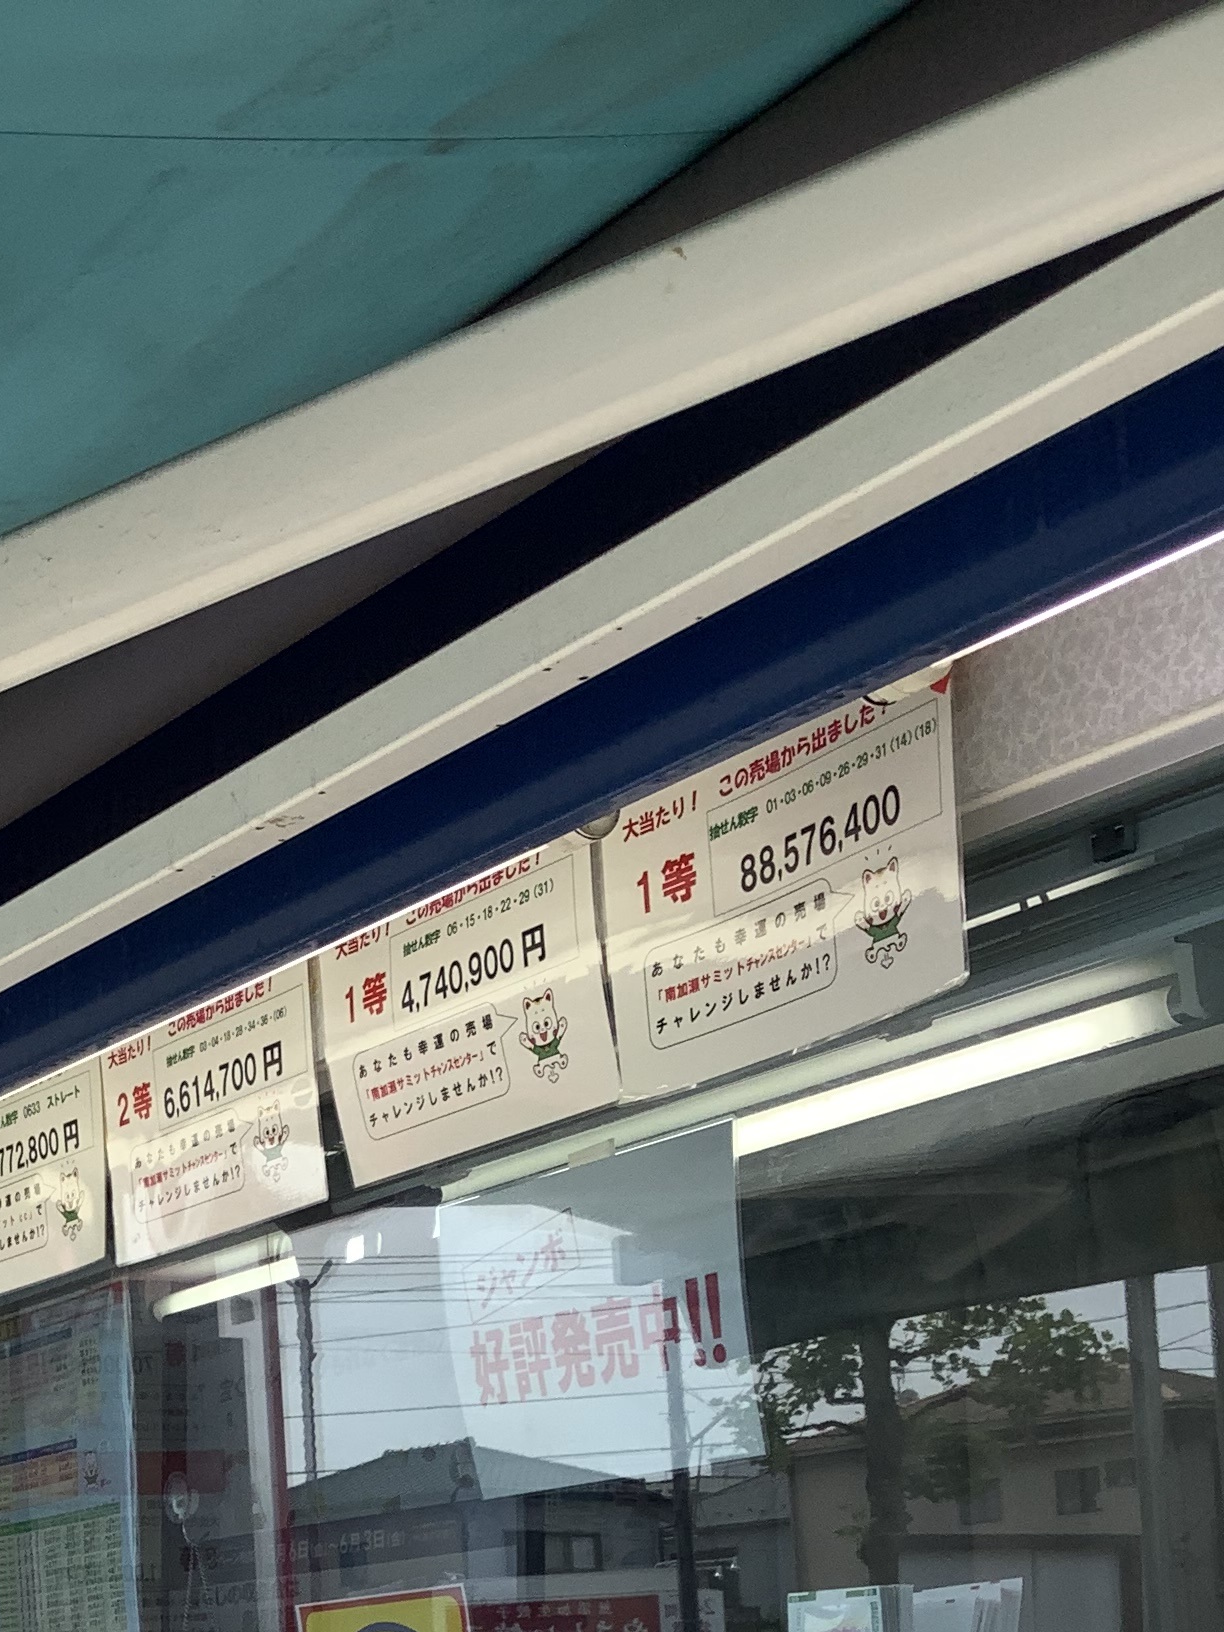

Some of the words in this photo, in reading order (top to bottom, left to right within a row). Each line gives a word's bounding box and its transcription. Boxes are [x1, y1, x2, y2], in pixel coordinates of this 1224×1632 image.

[623, 790, 697, 841] 大当たり！
[638, 852, 697, 913] 1等
[741, 785, 900, 892] 88,576,400
[345, 972, 388, 1022] 1等
[402, 923, 546, 1013] 4,740,900円
[651, 892, 825, 977] あなたも幸運の売場
[656, 955, 831, 1034] チャレンジしませんか!?
[118, 1082, 152, 1127] 2等
[164, 1040, 282, 1119] 6,614,700円
[359, 1013, 493, 1078] あなたも幸運の売場
[370, 1067, 504, 1127] チャレンジしませんか!?
[477, 1227, 566, 1309] ジャンボ
